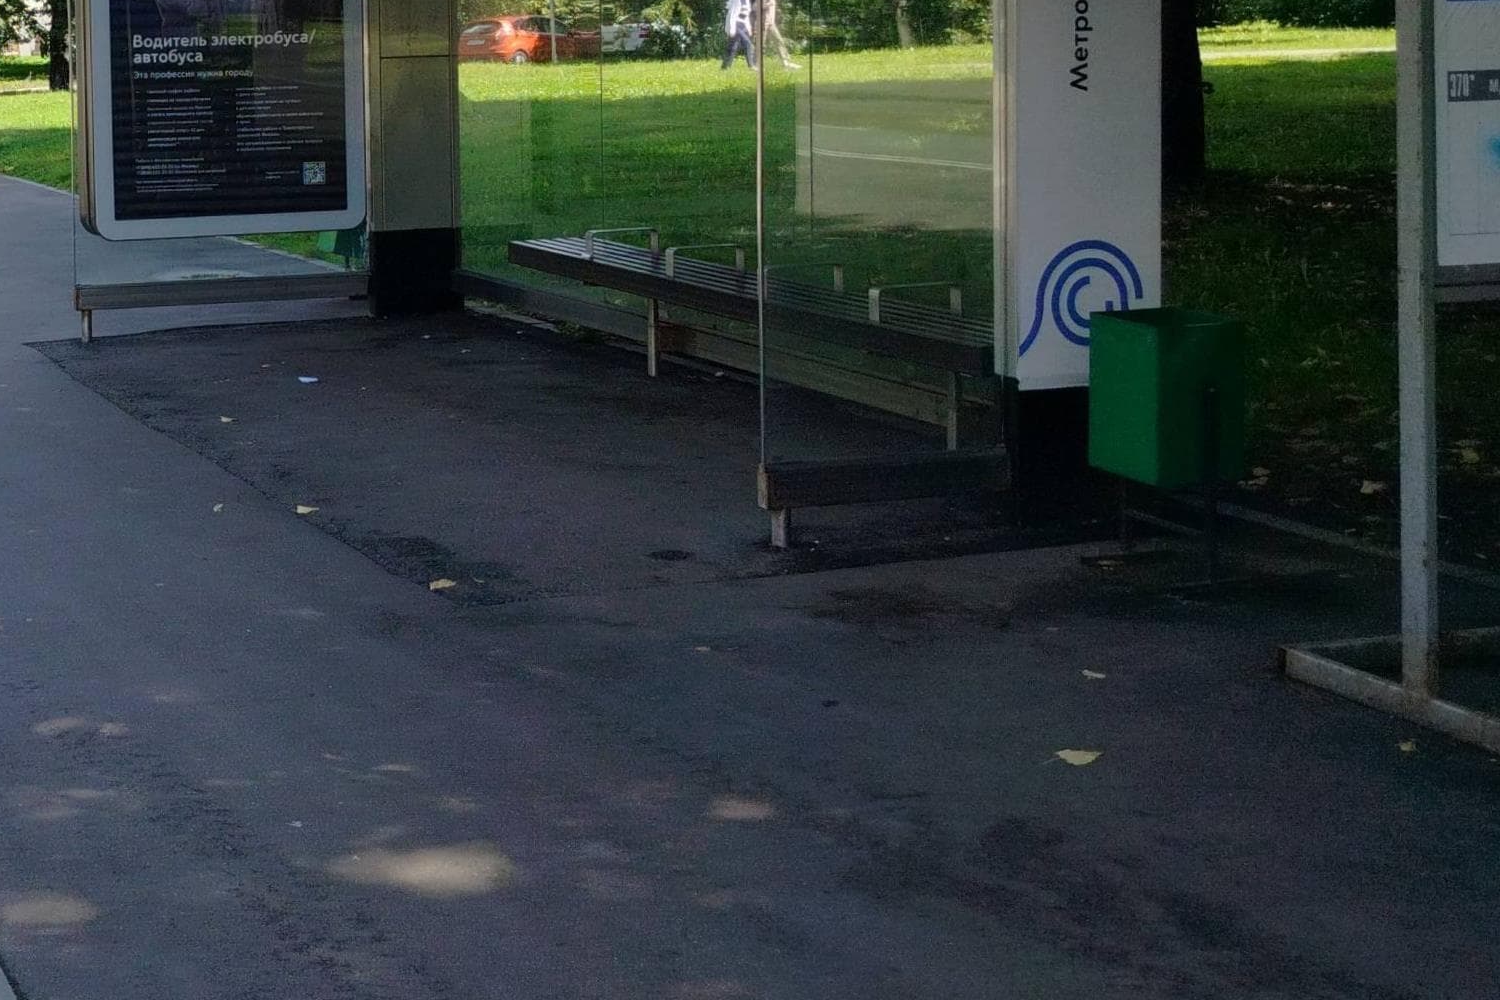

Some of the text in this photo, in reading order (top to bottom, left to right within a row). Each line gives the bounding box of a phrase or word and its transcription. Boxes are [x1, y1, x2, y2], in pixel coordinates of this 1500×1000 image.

[133, 29, 316, 49] Водитель электробуса/
[1070, 0, 1092, 91] Метро
[133, 49, 203, 65] автобуса
[134, 70, 149, 79] Эта
[150, 70, 195, 80] профессия
